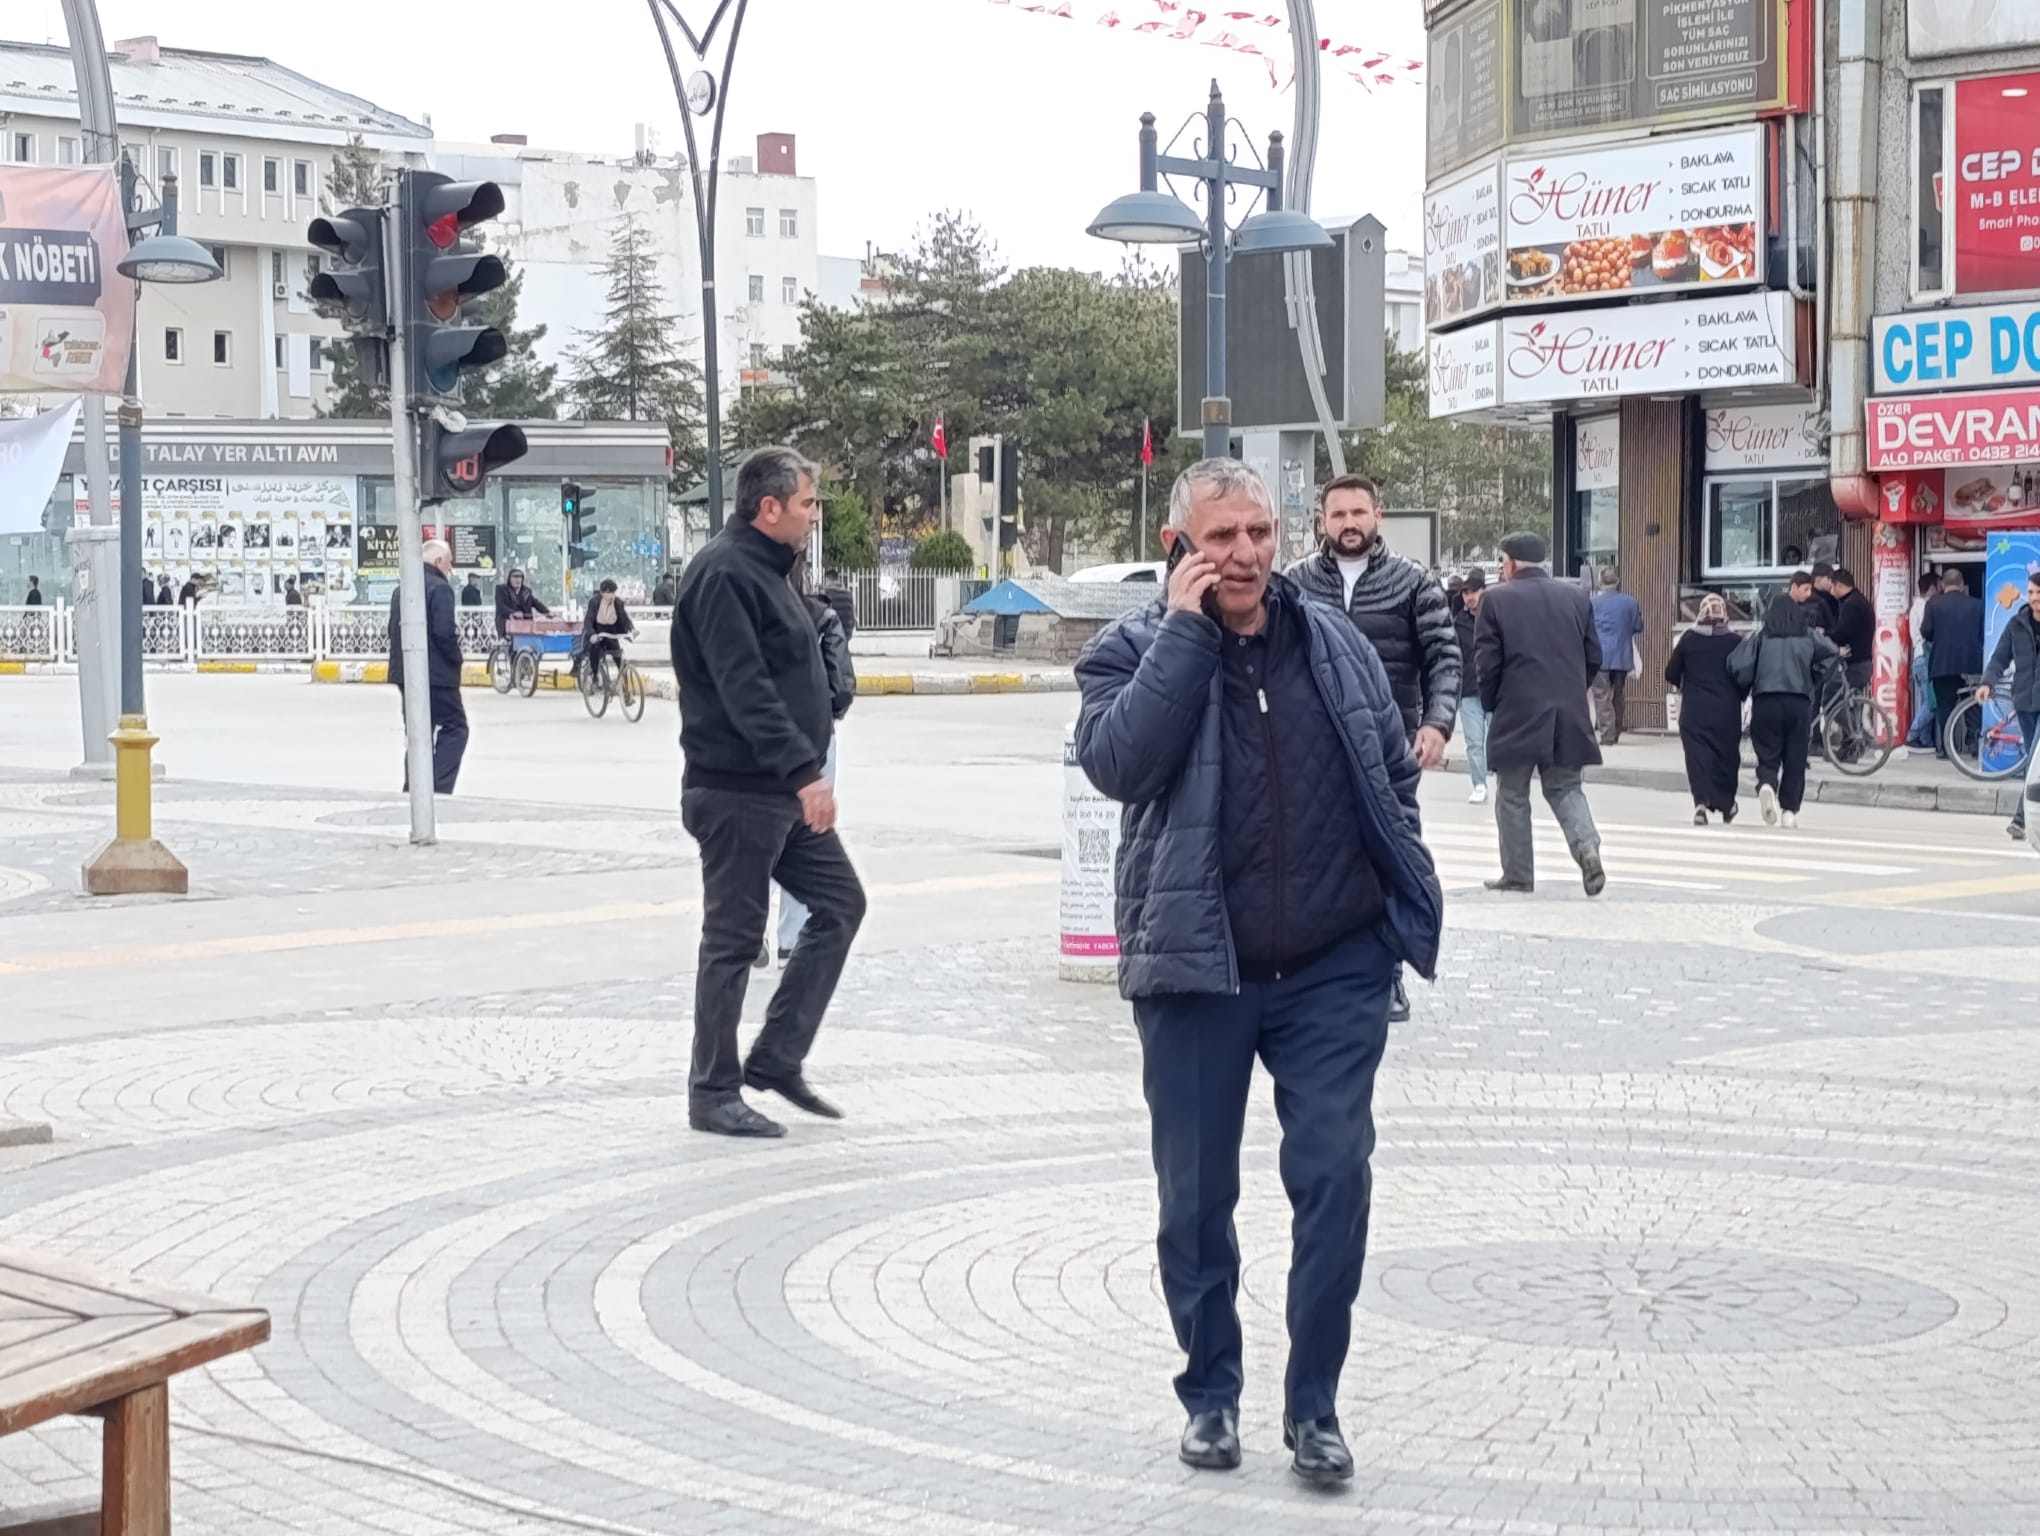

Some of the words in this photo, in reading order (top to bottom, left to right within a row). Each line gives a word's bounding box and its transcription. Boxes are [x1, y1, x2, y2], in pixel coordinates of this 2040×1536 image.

[1682, 26, 1705, 41] TÜM
[1663, 60, 1685, 72] SON
[1687, 50, 1749, 68] VERİYORUZ
[1660, 88, 1680, 104] SAÇ
[1682, 76, 1753, 97] SİMİLASYONU
[1681, 151, 1735, 169] BAKLAVA
[1961, 149, 2021, 182] CEP
[1681, 180, 1717, 196] SICAK
[1721, 176, 1750, 192] TATLI
[1509, 171, 1662, 225] Hüner
[1970, 190, 2003, 209] M-B
[2009, 187, 2040, 206] ELE
[1681, 204, 1753, 222] DONDURMA
[1576, 222, 1610, 238] TATLI
[14, 237, 96, 284] NÖBETİ
[1698, 310, 1758, 327] BAKLAVA
[1507, 327, 1676, 379] Hüner
[1698, 338, 1738, 353] SICAK
[1744, 335, 1776, 349] TATLI
[1883, 320, 1973, 384] CEP
[1698, 363, 1779, 380] DONDURMA
[1580, 378, 1619, 393] TATLI
[1877, 402, 1911, 416] ÖZER
[1705, 415, 1795, 452] Hüner
[149, 445, 206, 462] TALAY
[212, 446, 247, 462] YER
[252, 446, 293, 462] ALTI
[296, 446, 338, 462] AVM
[1744, 454, 1765, 465] TATLI
[1880, 452, 1908, 466] ALO
[1969, 443, 2010, 461] 0432
[153, 478, 223, 495] ÇARŞISI
